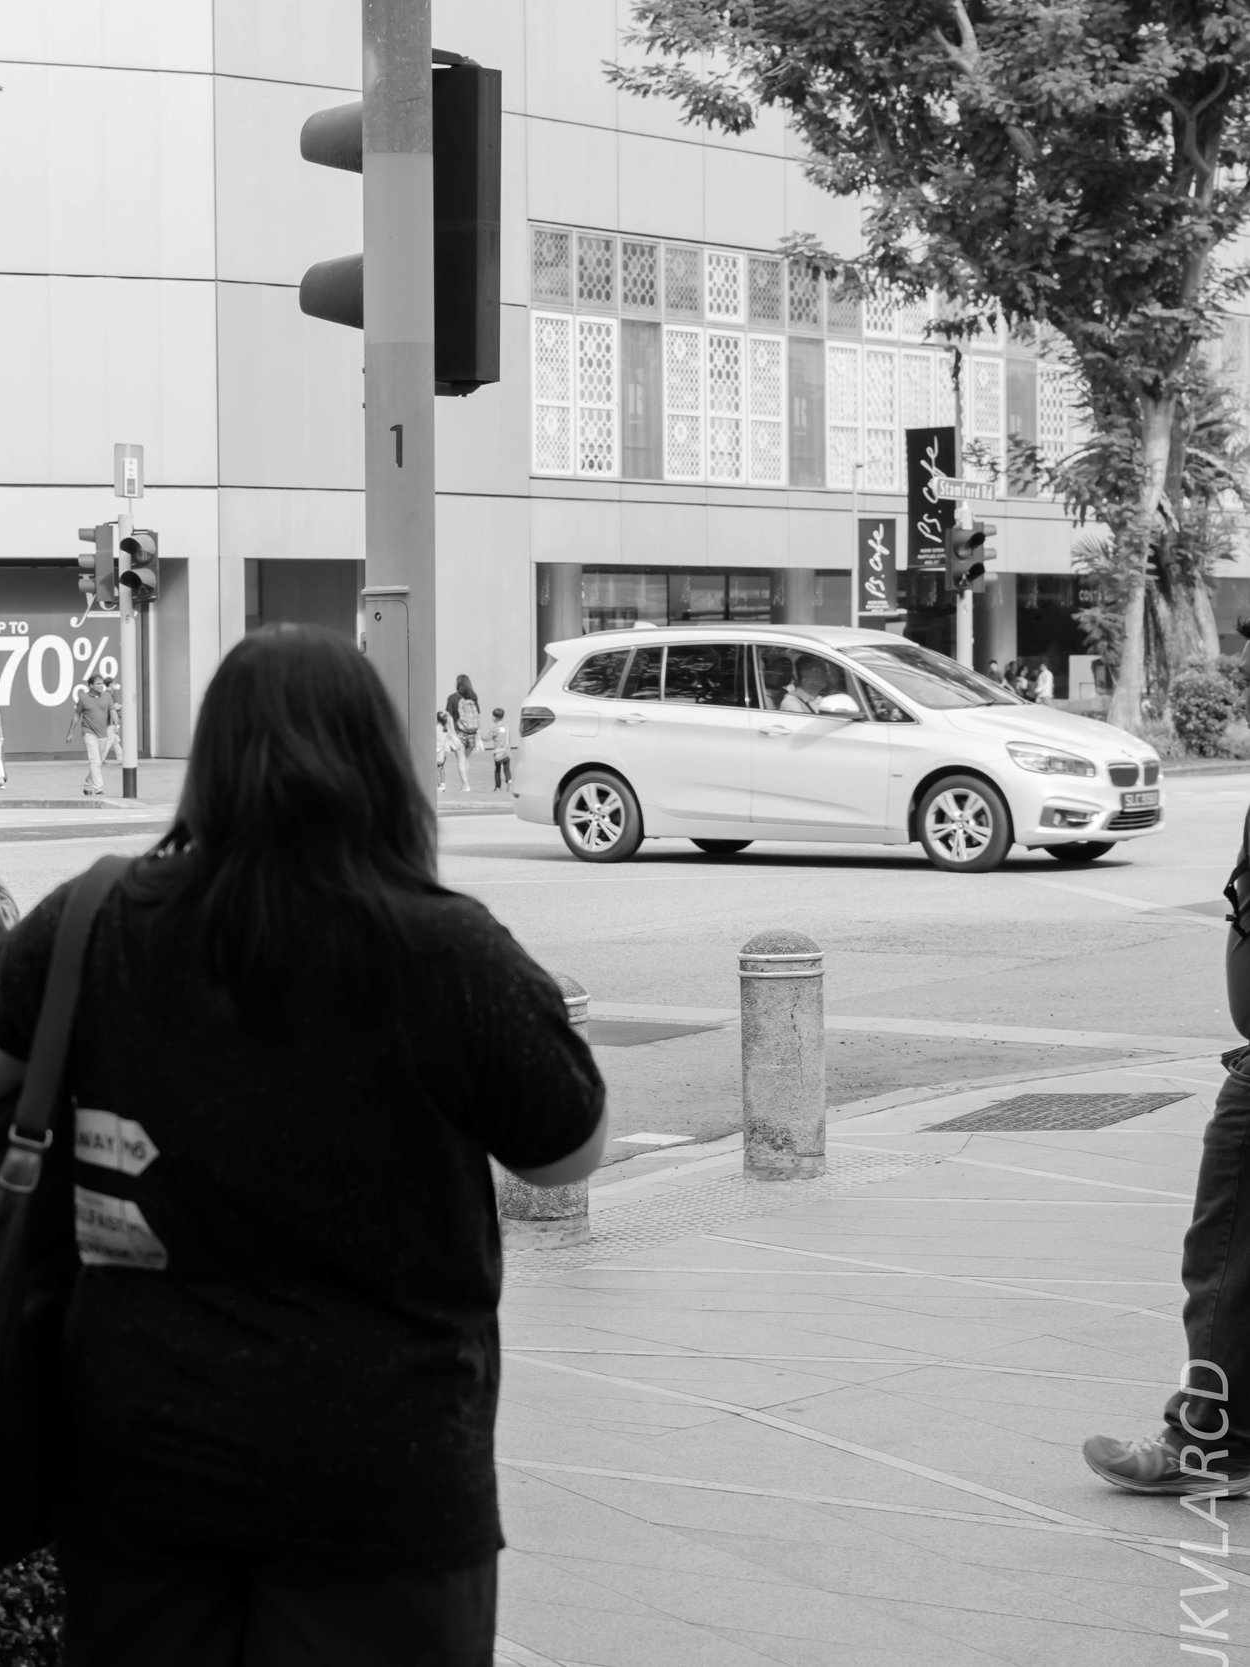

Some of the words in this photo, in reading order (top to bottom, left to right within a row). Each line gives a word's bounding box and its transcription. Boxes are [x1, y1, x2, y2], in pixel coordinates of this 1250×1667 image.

[390, 424, 403, 468] 1
[939, 480, 981, 499] Stamford
[981, 484, 993, 500] Rd
[9, 621, 29, 634] TO
